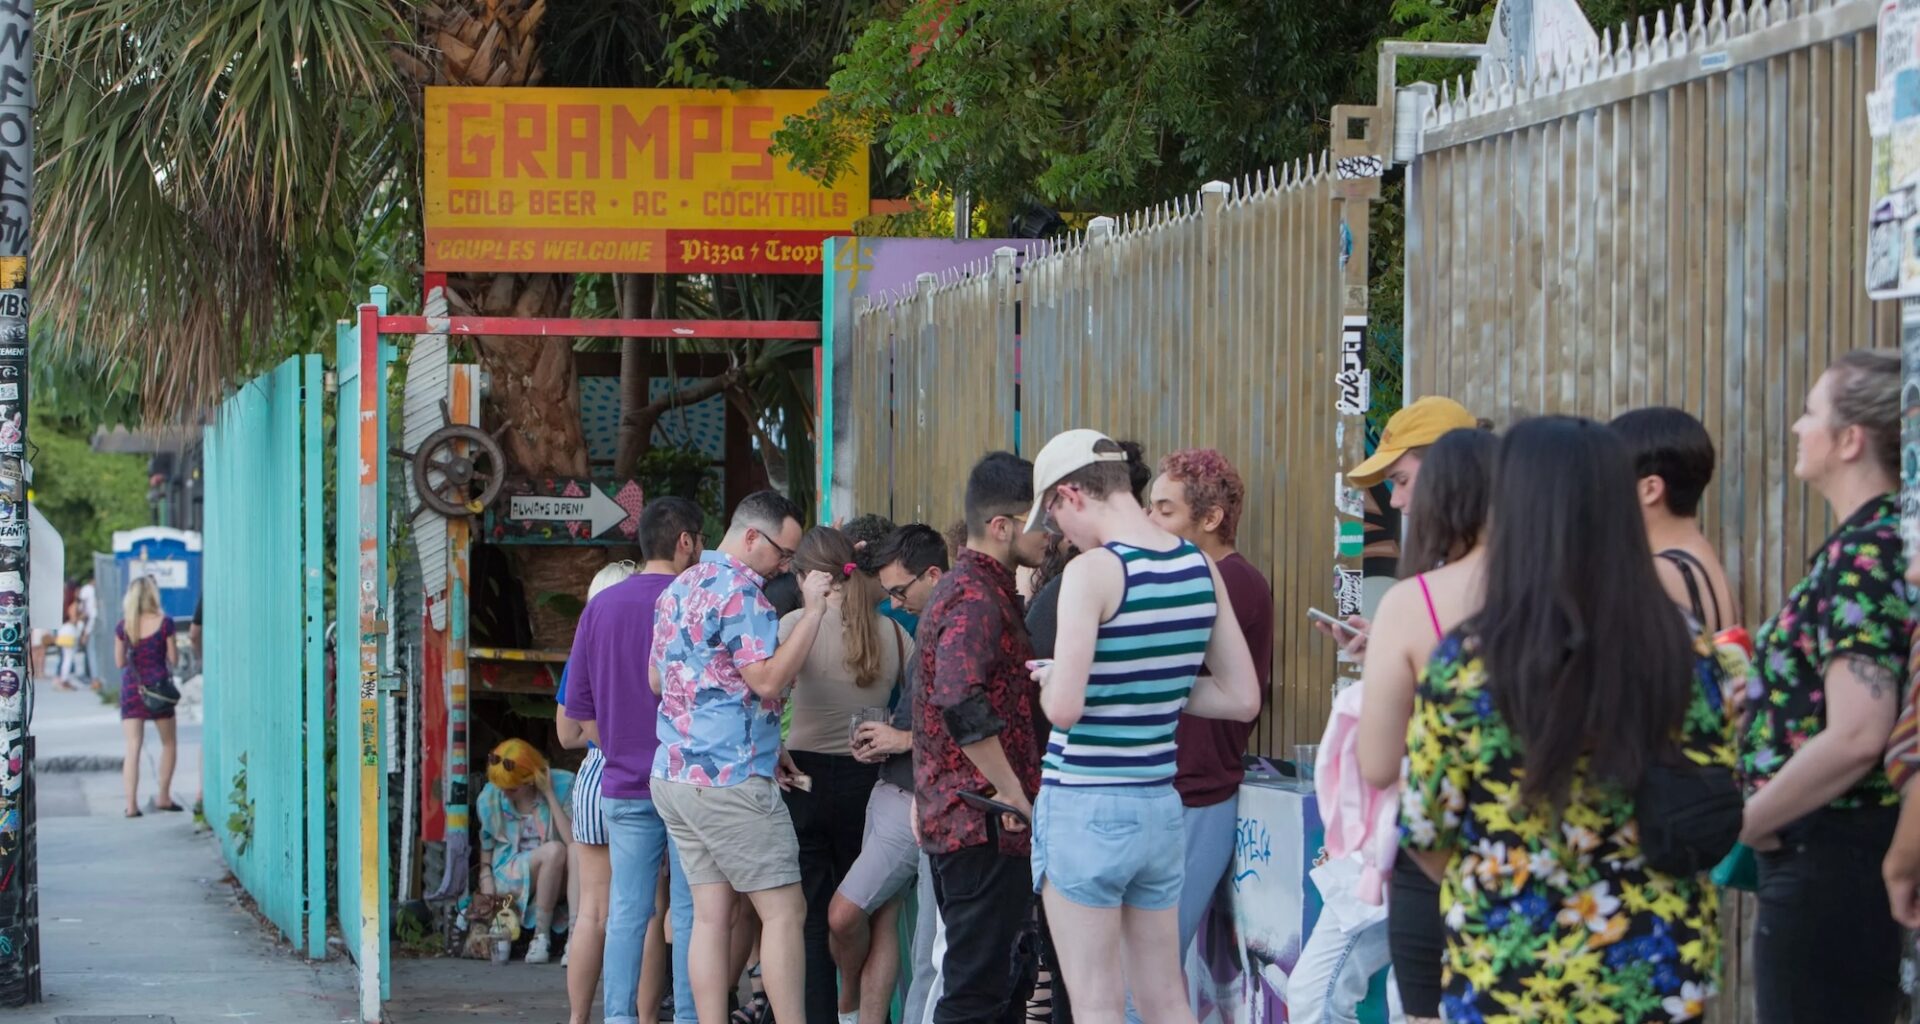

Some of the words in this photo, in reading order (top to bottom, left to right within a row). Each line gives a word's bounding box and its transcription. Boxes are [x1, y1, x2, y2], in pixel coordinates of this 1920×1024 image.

[447, 103, 774, 180] GRAMPS
[448, 189, 514, 215] COLD
[529, 189, 596, 216] BEER
[633, 191, 667, 216] AC
[703, 191, 848, 217] COCKTAILS
[436, 239, 535, 261] COUPLES
[543, 240, 652, 261] WELCOME
[680, 240, 745, 264] Pizza
[513, 501, 551, 516] ALWAYS
[554, 502, 584, 515] OPEN!
